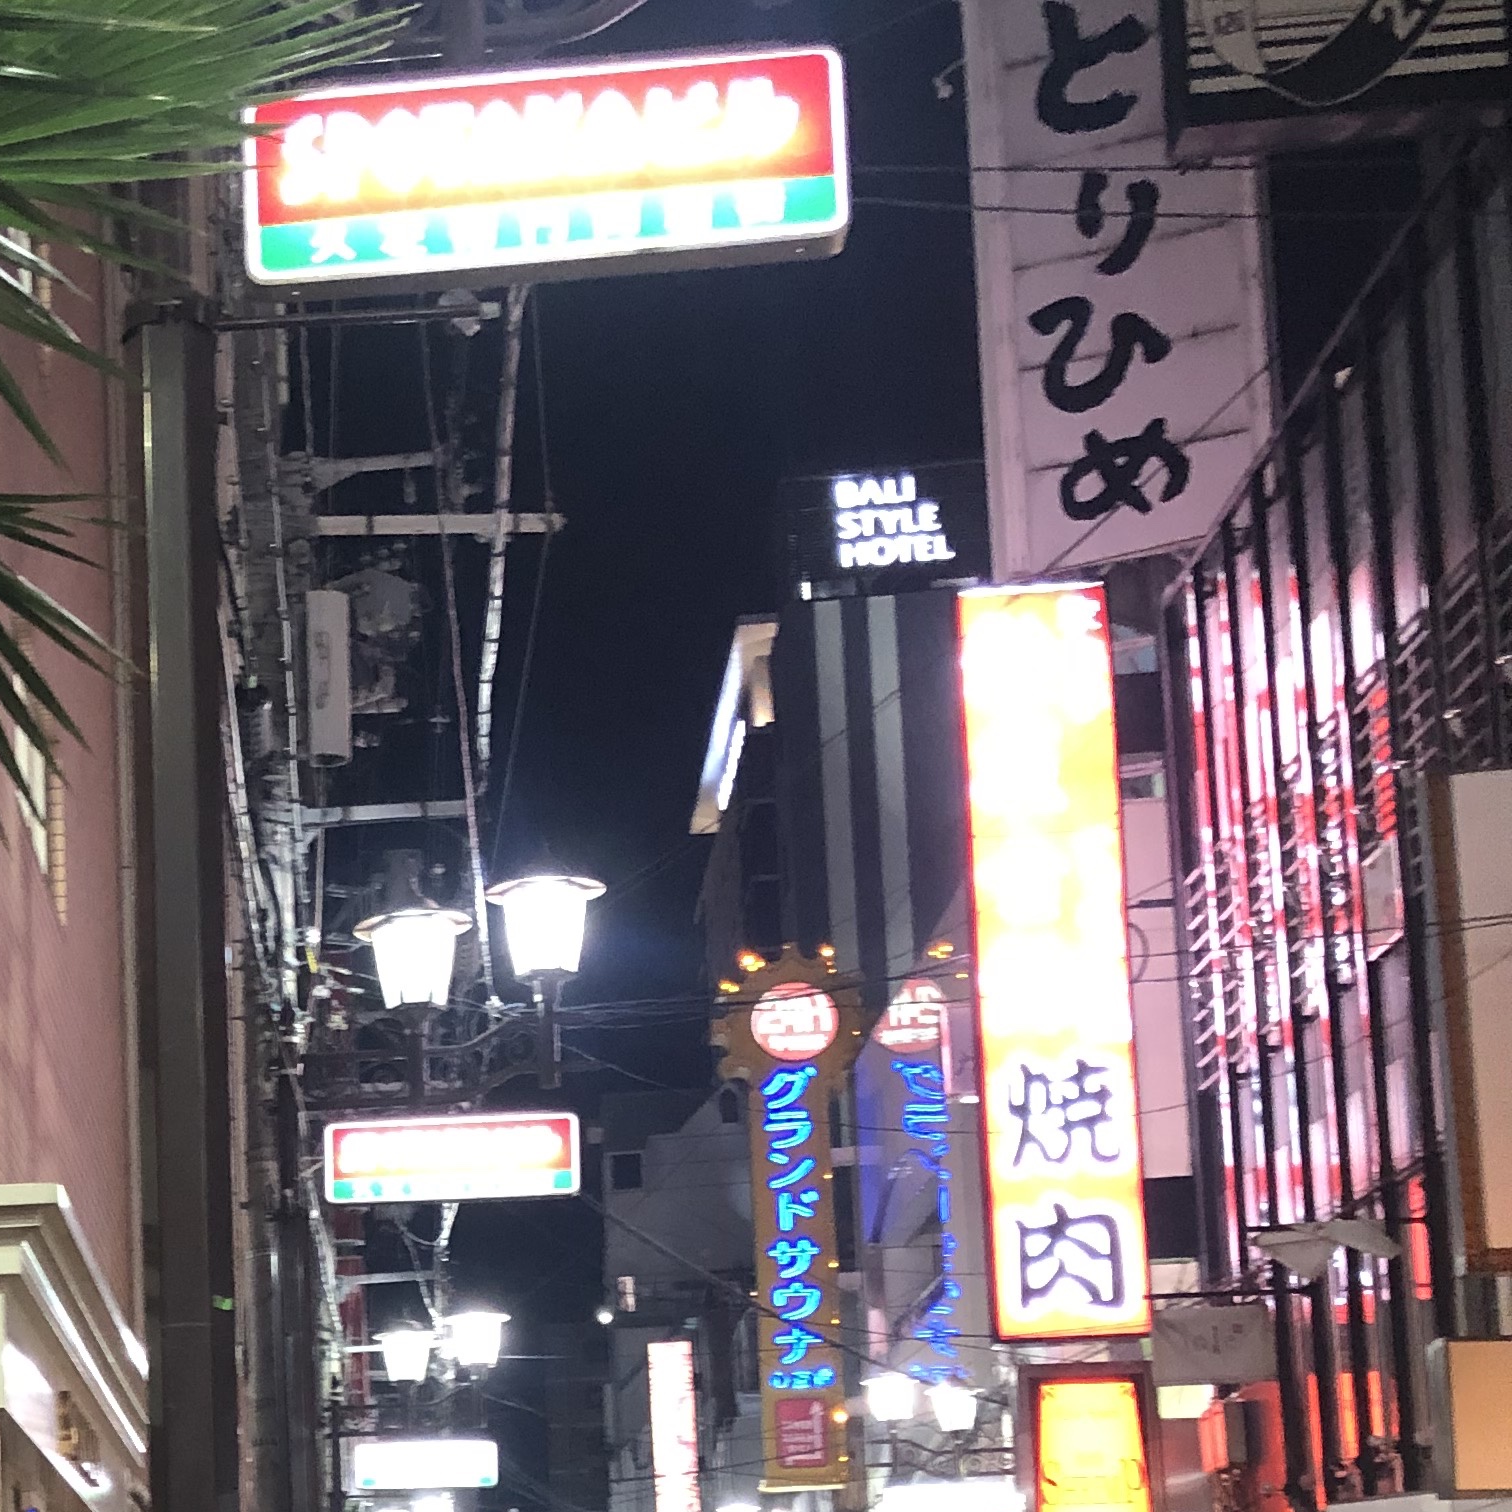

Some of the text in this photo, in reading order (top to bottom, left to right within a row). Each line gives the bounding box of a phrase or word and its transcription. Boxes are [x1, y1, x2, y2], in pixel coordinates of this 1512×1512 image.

[1028, 0, 1190, 521] とりひめ
[833, 475, 917, 510] BALI
[835, 502, 943, 541] STYLE
[838, 533, 957, 569] HOTEL
[759, 1064, 825, 1366] グランドサウナ
[1008, 1059, 1126, 1309] 焼肉
